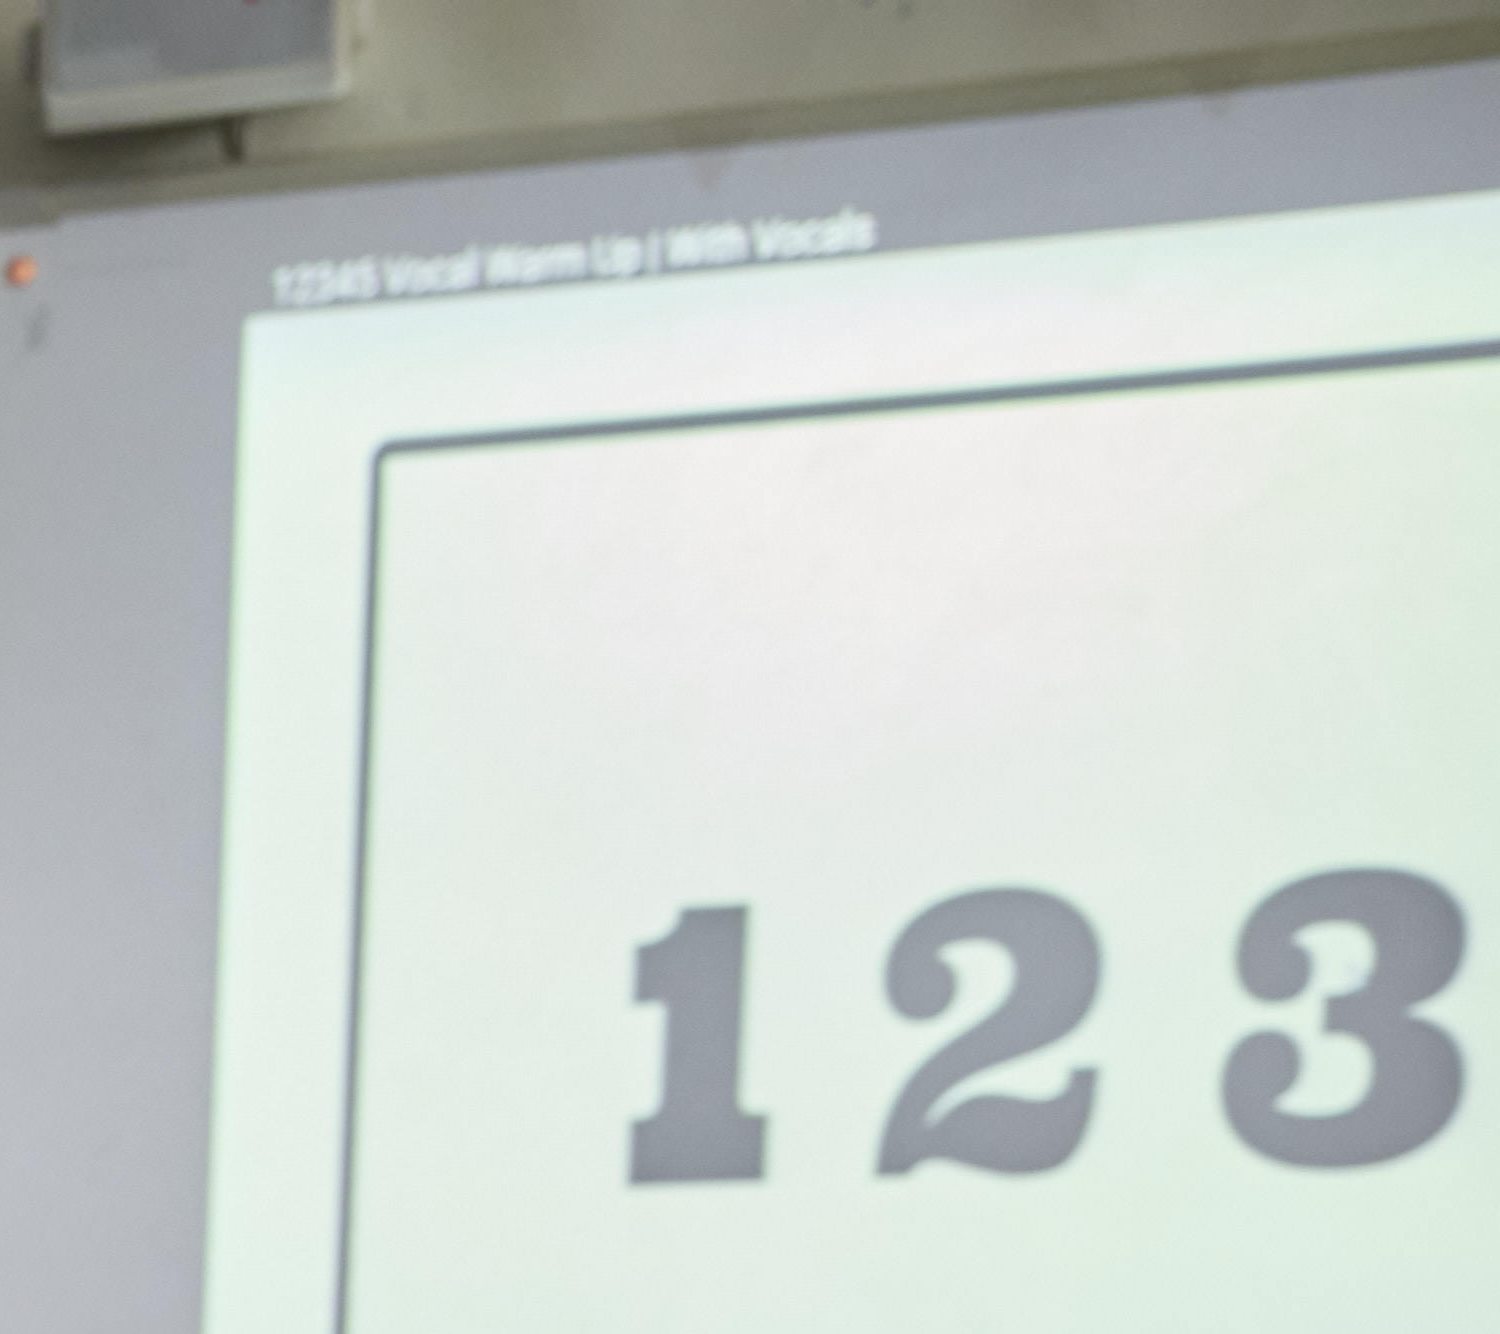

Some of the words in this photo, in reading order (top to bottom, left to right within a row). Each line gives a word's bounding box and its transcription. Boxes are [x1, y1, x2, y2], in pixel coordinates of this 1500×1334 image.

[273, 253, 378, 305] 12345
[382, 243, 479, 297] Vocal
[484, 240, 587, 288] Warm
[591, 232, 641, 278] Up
[665, 219, 748, 269] With
[753, 205, 873, 262] Vocals
[628, 904, 768, 1185] 1
[873, 886, 1103, 1177] 2
[1221, 867, 1469, 1171] 3
